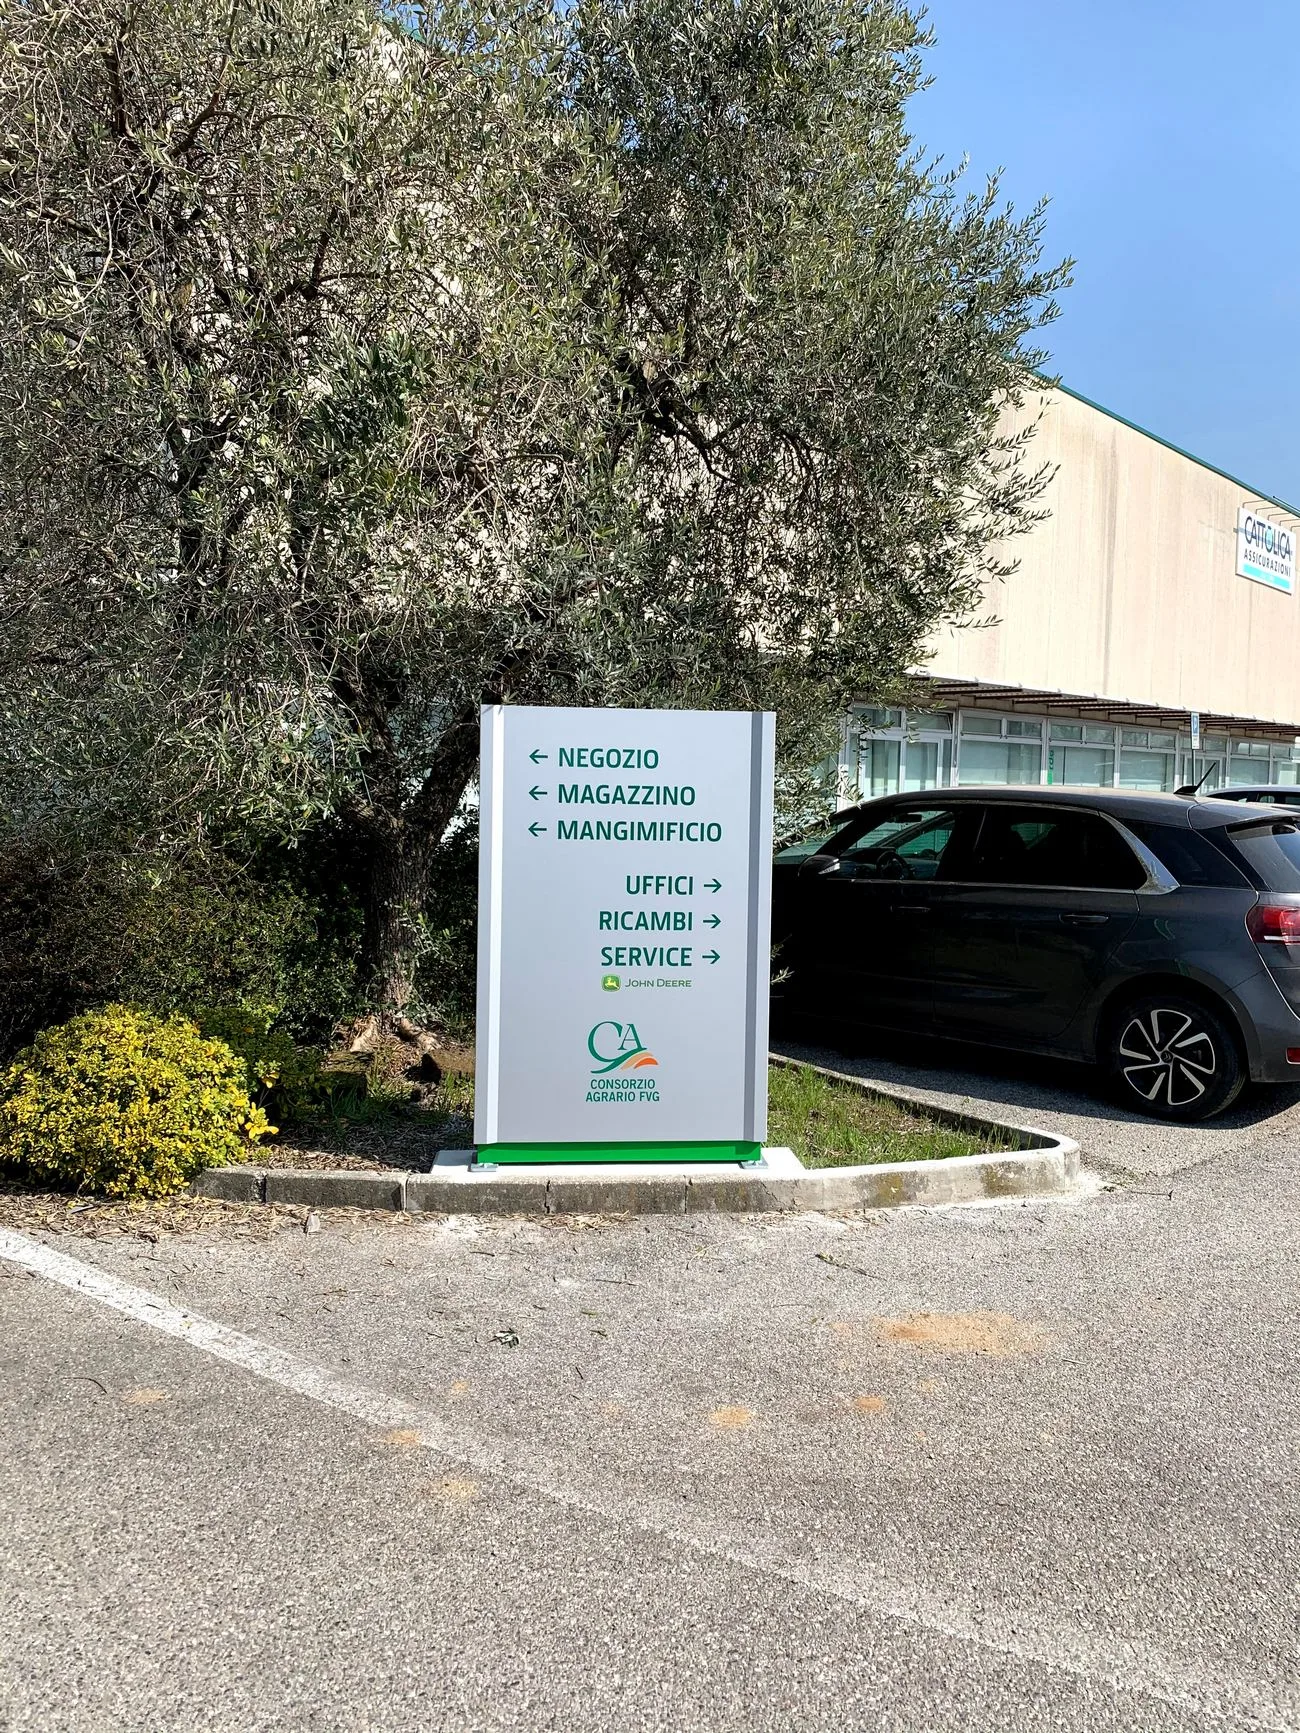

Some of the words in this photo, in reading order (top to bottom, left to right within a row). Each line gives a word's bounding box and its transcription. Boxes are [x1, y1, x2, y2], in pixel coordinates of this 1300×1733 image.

[1244, 516, 1291, 561] CATTOLICA
[1243, 548, 1291, 577] ASSICURAZIONI
[558, 748, 659, 769] NEGOZIO
[558, 784, 696, 806] MAGAZZINO
[557, 820, 722, 842] MANGIMIFICIO
[626, 875, 693, 895] UFFICI
[599, 911, 692, 931] RICAMBI
[601, 947, 692, 966] SERVICE
[625, 978, 655, 988] JOHN
[657, 978, 692, 988] DEERE
[590, 1079, 655, 1090] CONSORZIO
[586, 1091, 636, 1102] AGRARIO
[639, 1091, 660, 1102] FVG
